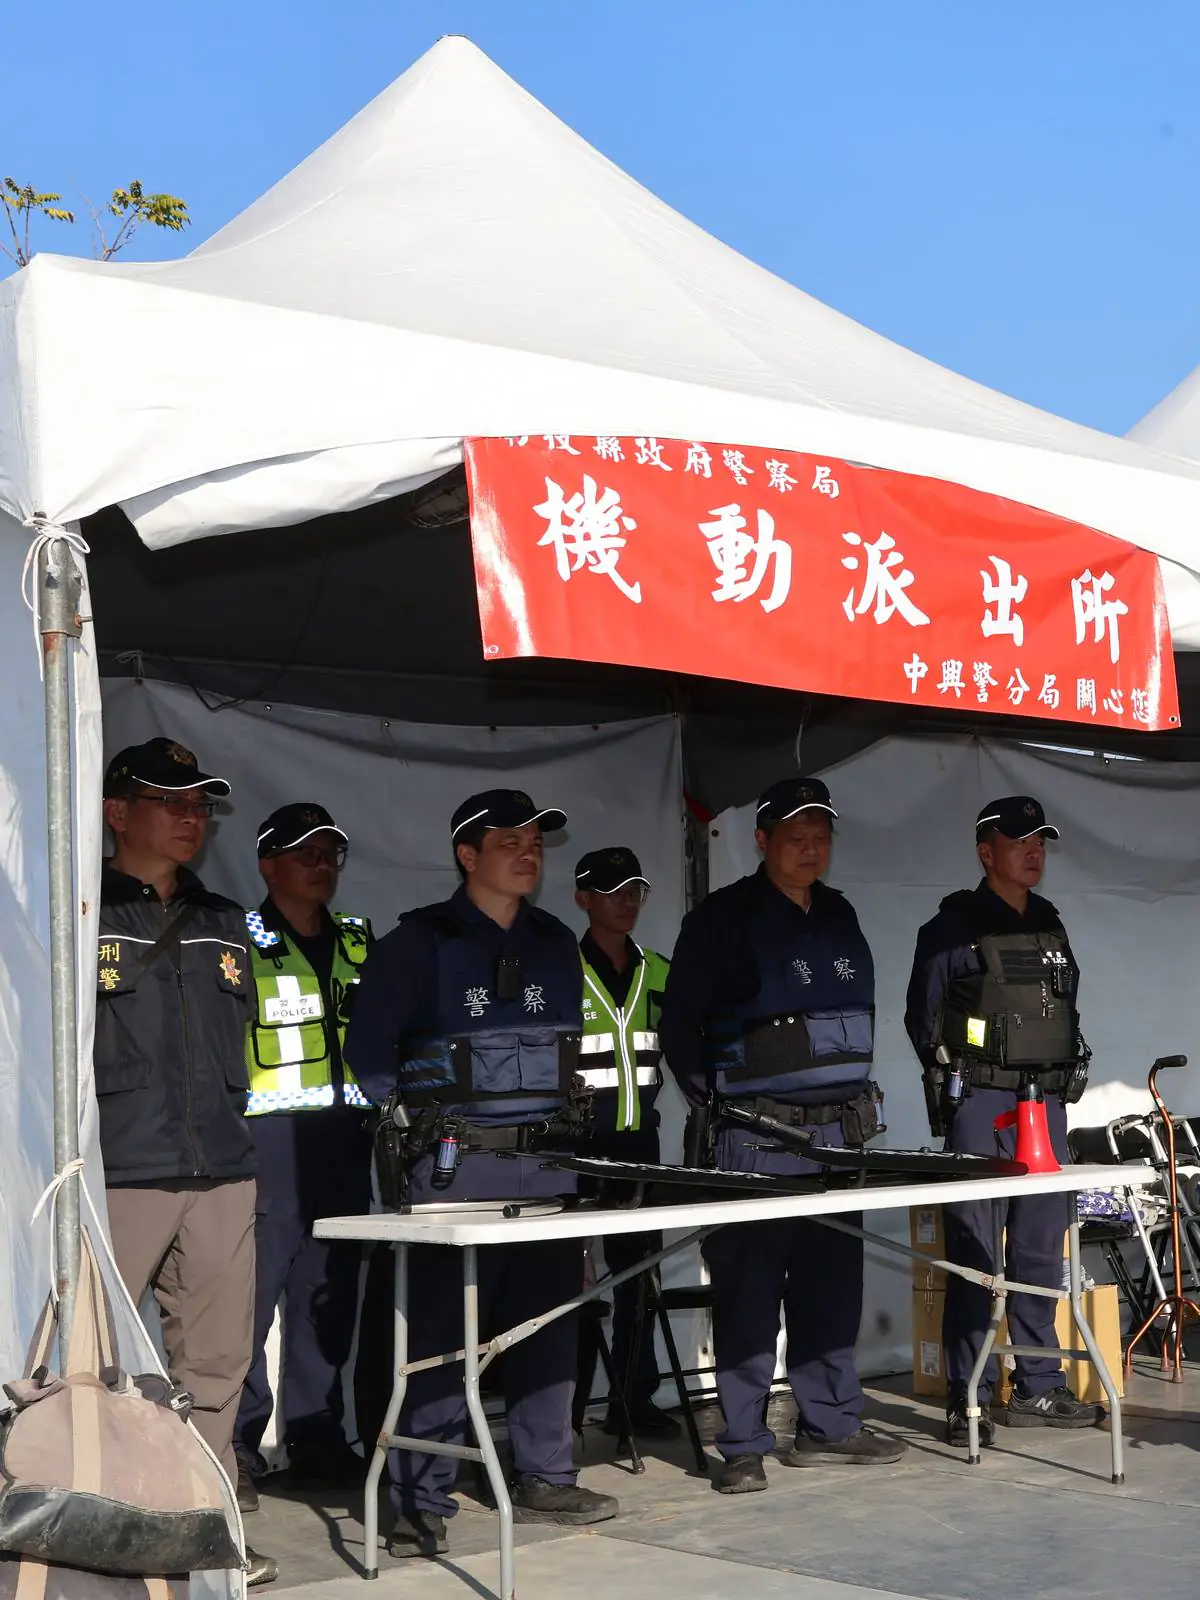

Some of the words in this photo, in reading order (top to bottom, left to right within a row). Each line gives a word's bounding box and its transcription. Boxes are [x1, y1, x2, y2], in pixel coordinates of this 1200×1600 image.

[533, 473, 1130, 664] 機動派出所
[98, 942, 121, 990] 刑警
[793, 957, 856, 986] 警察
[272, 1007, 315, 1017] POLICE
[463, 983, 547, 1018] 警察
